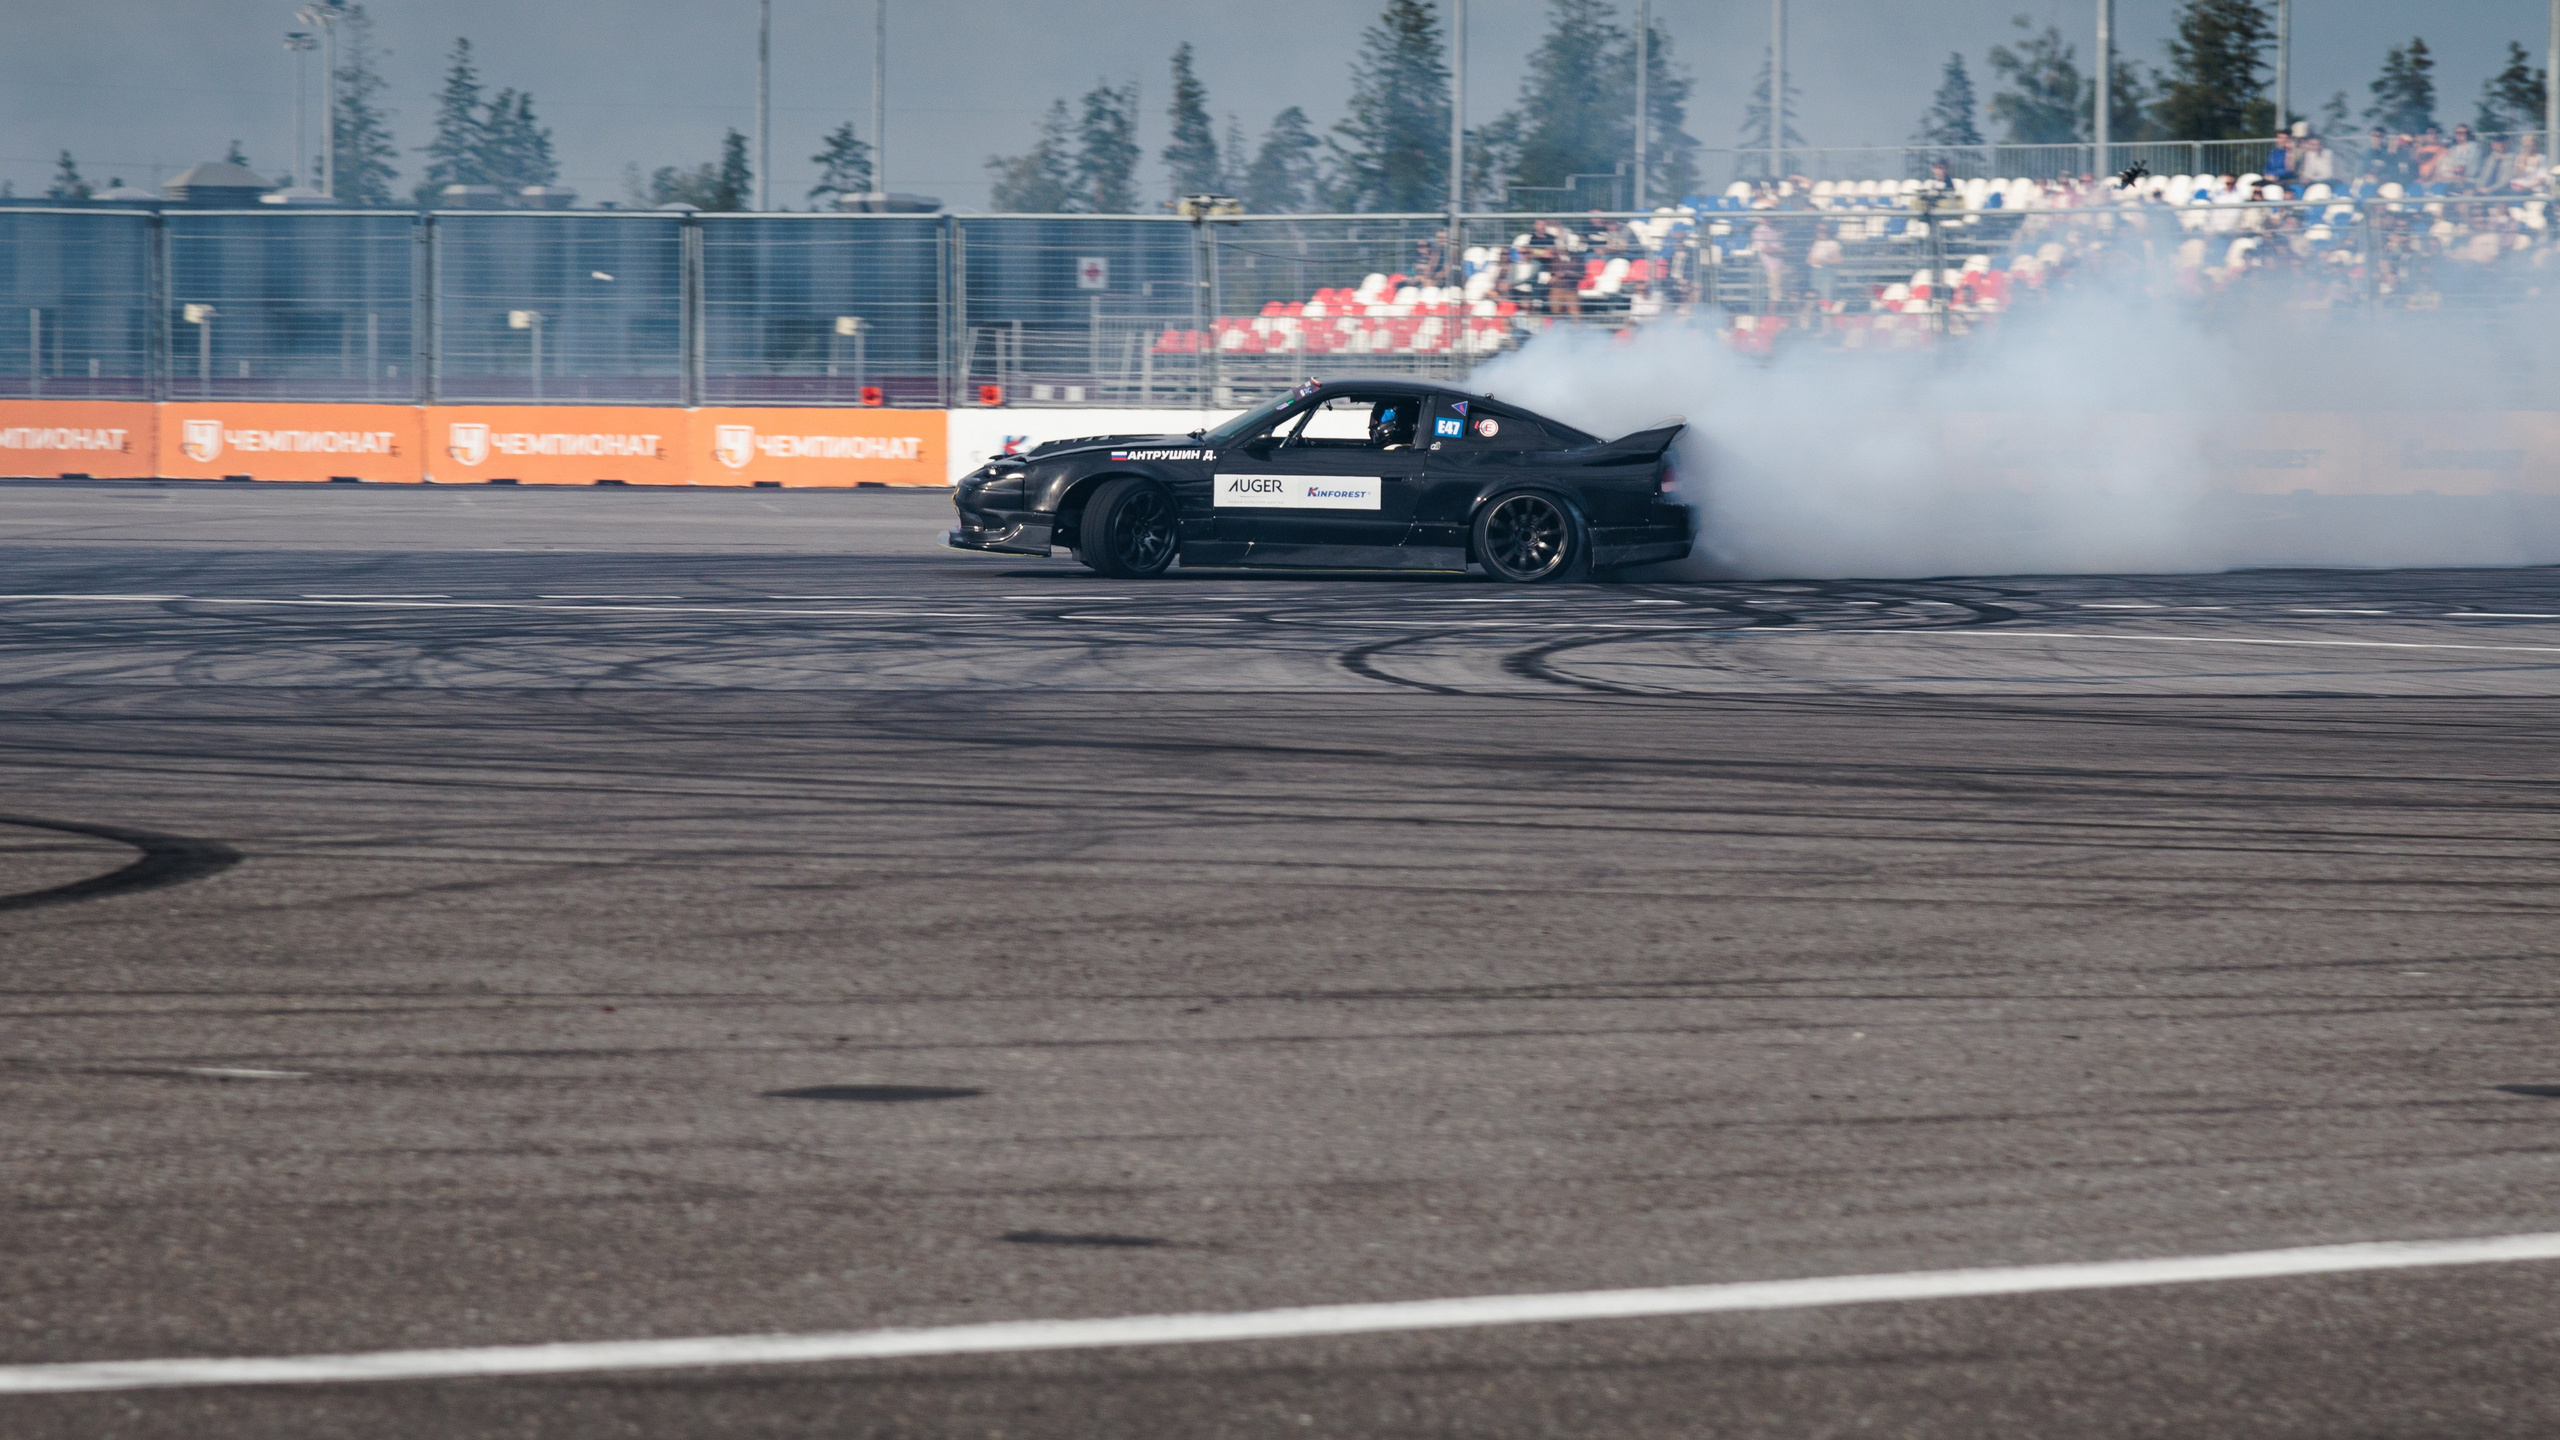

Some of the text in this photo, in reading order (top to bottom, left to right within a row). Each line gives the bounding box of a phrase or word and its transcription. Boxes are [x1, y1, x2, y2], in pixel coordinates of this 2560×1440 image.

[1437, 419, 1461, 436] E47
[224, 430, 395, 453] ЧЕМПИОНАТ
[491, 433, 662, 456] ЧЕМПИОНАТ
[755, 435, 922, 459] ЧЕМПИОНАТ
[1127, 450, 1217, 461] АНТРУШИН Д.
[1228, 479, 1284, 493] AUGER
[1307, 487, 1367, 498] KINFOREST
